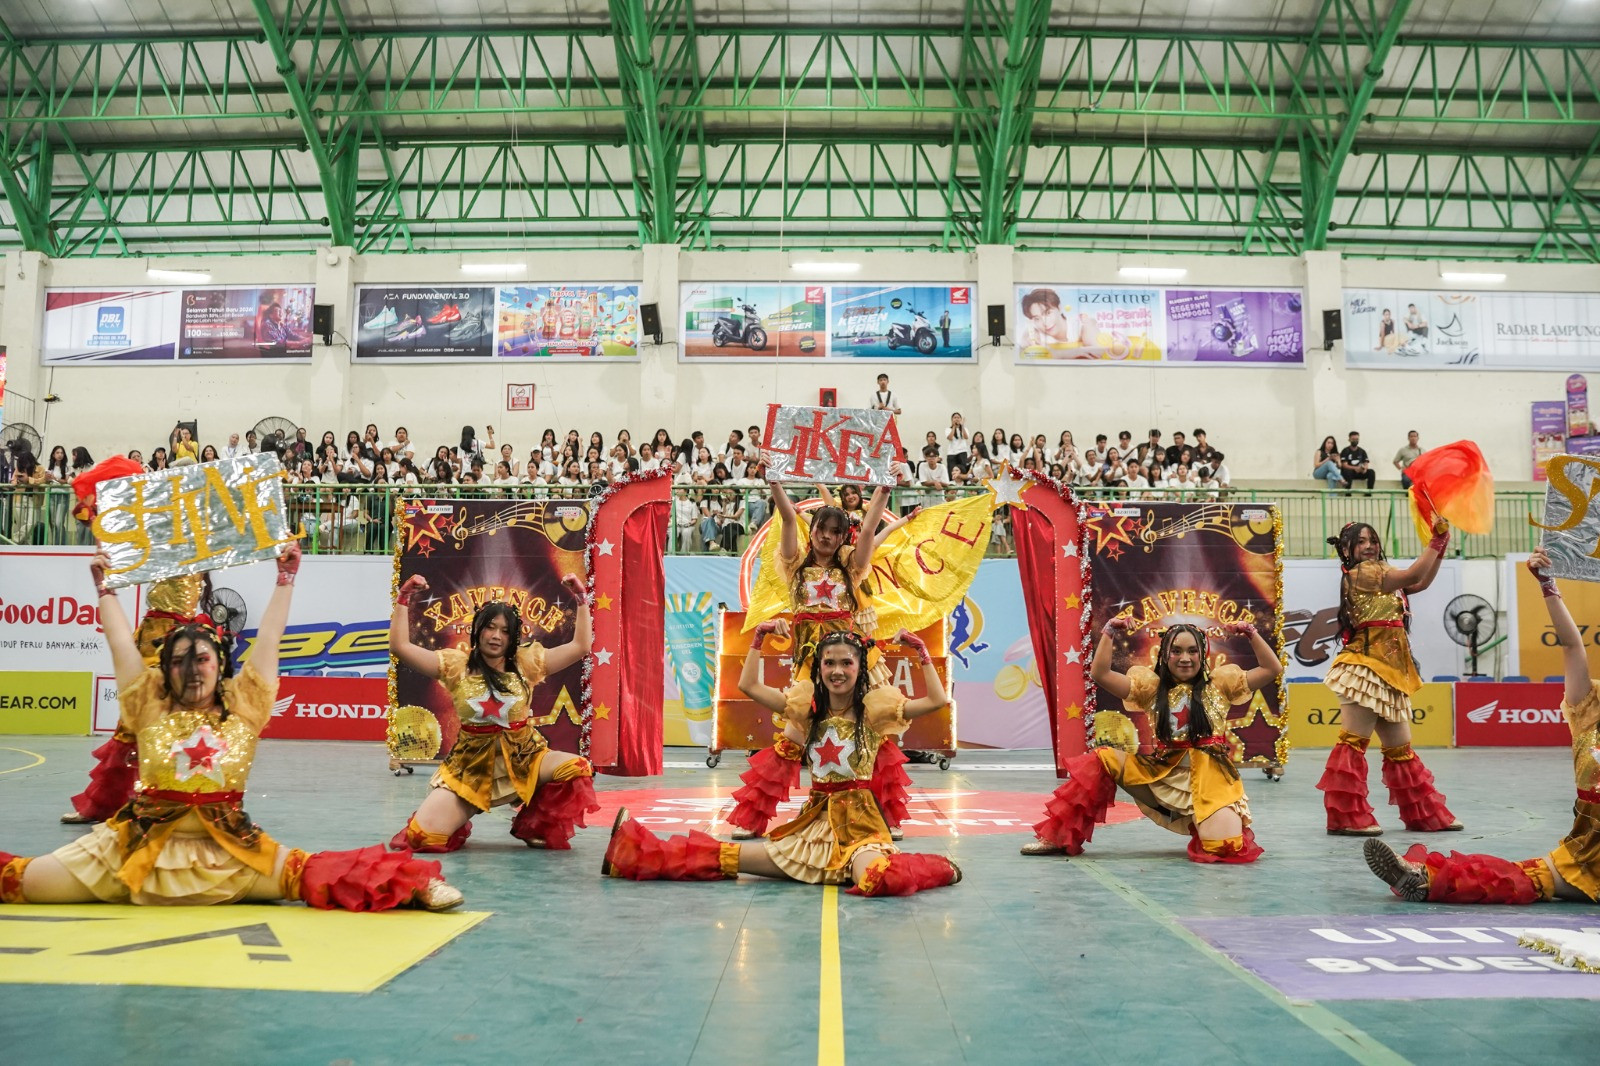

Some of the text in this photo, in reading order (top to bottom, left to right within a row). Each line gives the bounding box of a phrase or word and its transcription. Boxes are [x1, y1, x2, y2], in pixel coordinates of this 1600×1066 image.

[1078, 293, 1151, 304] azarine
[1170, 301, 1211, 314] SEGERNYA
[100, 313, 121, 323] DBL
[838, 313, 889, 327] KEREN
[1097, 311, 1114, 321] No
[778, 321, 813, 332] BENER
[1496, 322, 1539, 336] RADAR
[187, 329, 202, 337] 100
[1267, 332, 1300, 346] MOVE
[0, 597, 54, 624] ood
[20, 641, 43, 649] PERLU
[46, 641, 75, 650] BANYAK
[80, 642, 99, 651] RASA
